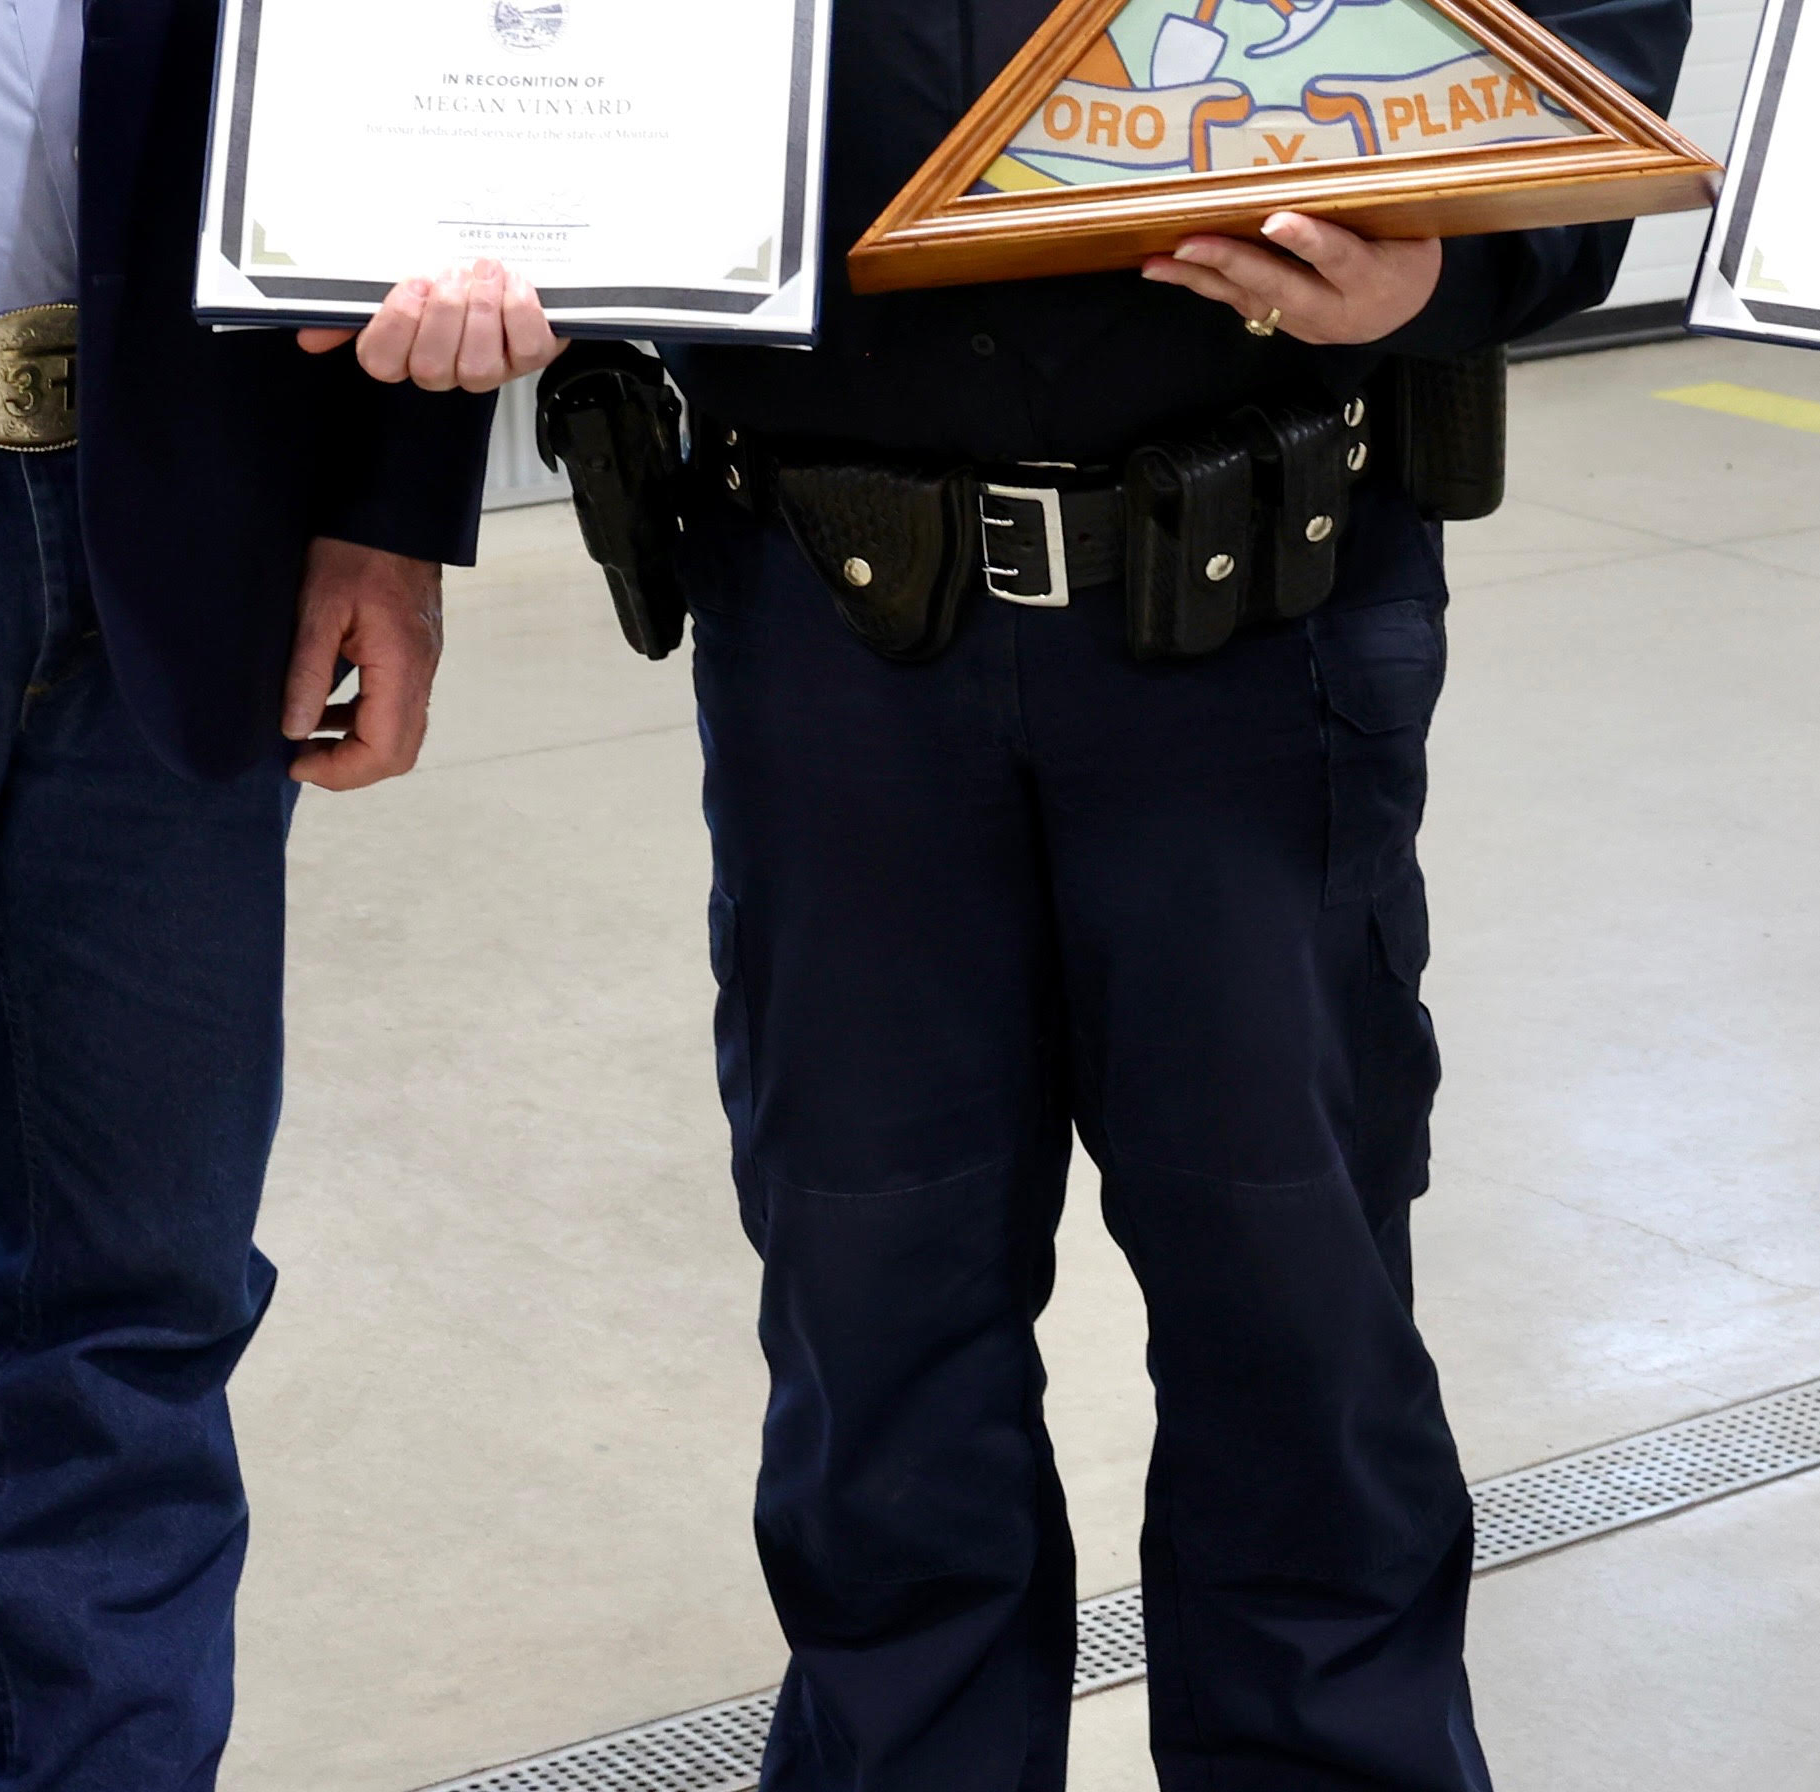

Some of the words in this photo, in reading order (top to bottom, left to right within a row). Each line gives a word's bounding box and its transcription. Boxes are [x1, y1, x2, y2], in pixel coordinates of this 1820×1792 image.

[443, 73, 458, 84] IN
[466, 74, 578, 87] RECOGNITION
[585, 77, 605, 87] OF
[414, 95, 505, 112] MEGAN
[517, 98, 632, 115] VINYARD
[1043, 94, 1165, 151] ORO
[1383, 72, 1538, 142] PLATA
[459, 229, 492, 239] GREG
